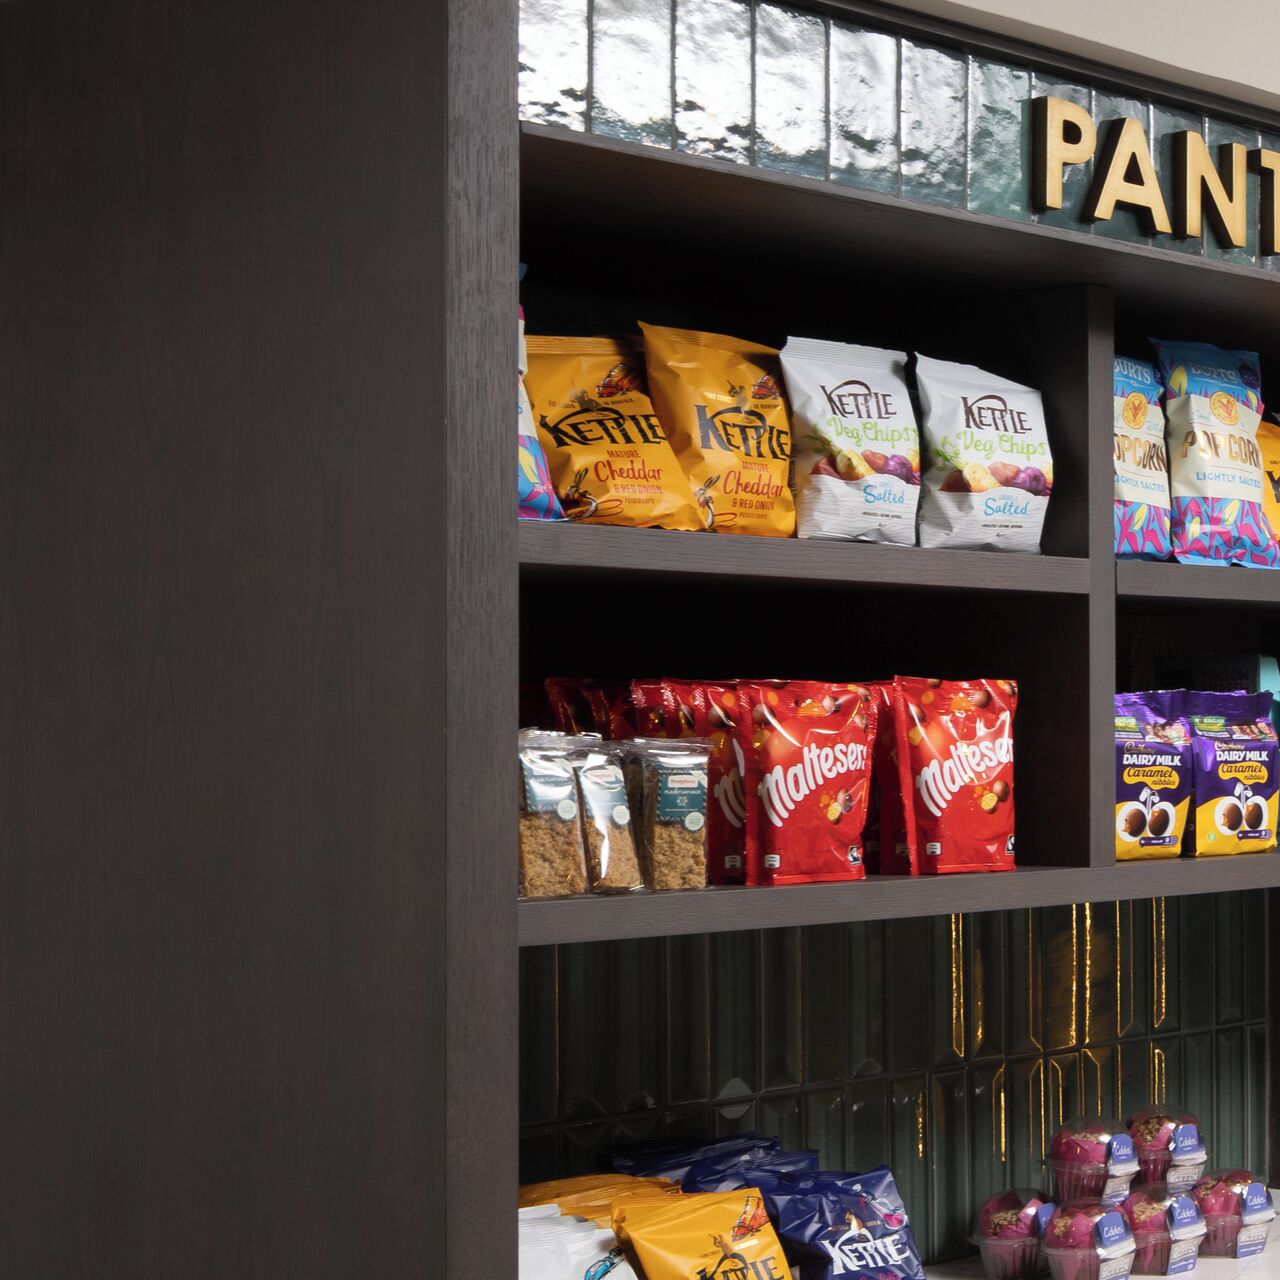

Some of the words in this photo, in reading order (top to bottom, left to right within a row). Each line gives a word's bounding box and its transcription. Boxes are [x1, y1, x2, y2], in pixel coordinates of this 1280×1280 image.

[819, 379, 898, 420] KETTLE
[539, 406, 668, 449] KETTLE
[960, 394, 1033, 435] KETTLE
[694, 404, 791, 462] KETTLE
[827, 416, 860, 448] Veg
[861, 420, 911, 449] Chips
[956, 430, 996, 460] Veg
[997, 432, 1048, 462] Chips
[1114, 432, 1168, 474] OPCORN
[593, 459, 664, 483] Cheddar
[1195, 471, 1236, 484] LIGHTLY
[863, 484, 905, 504] Salted
[984, 497, 1030, 516] Salted
[1122, 754, 1156, 766] DAIRY
[1156, 755, 1182, 766] MILK
[1216, 750, 1245, 762] DAIRY
[1245, 750, 1269, 762] MILK
[1221, 762, 1263, 774] Caramel
[915, 737, 1014, 817] Malteser
[1126, 766, 1174, 779] Caramel
[1150, 777, 1177, 787] nibbles
[820, 1227, 910, 1276] KETTLE
